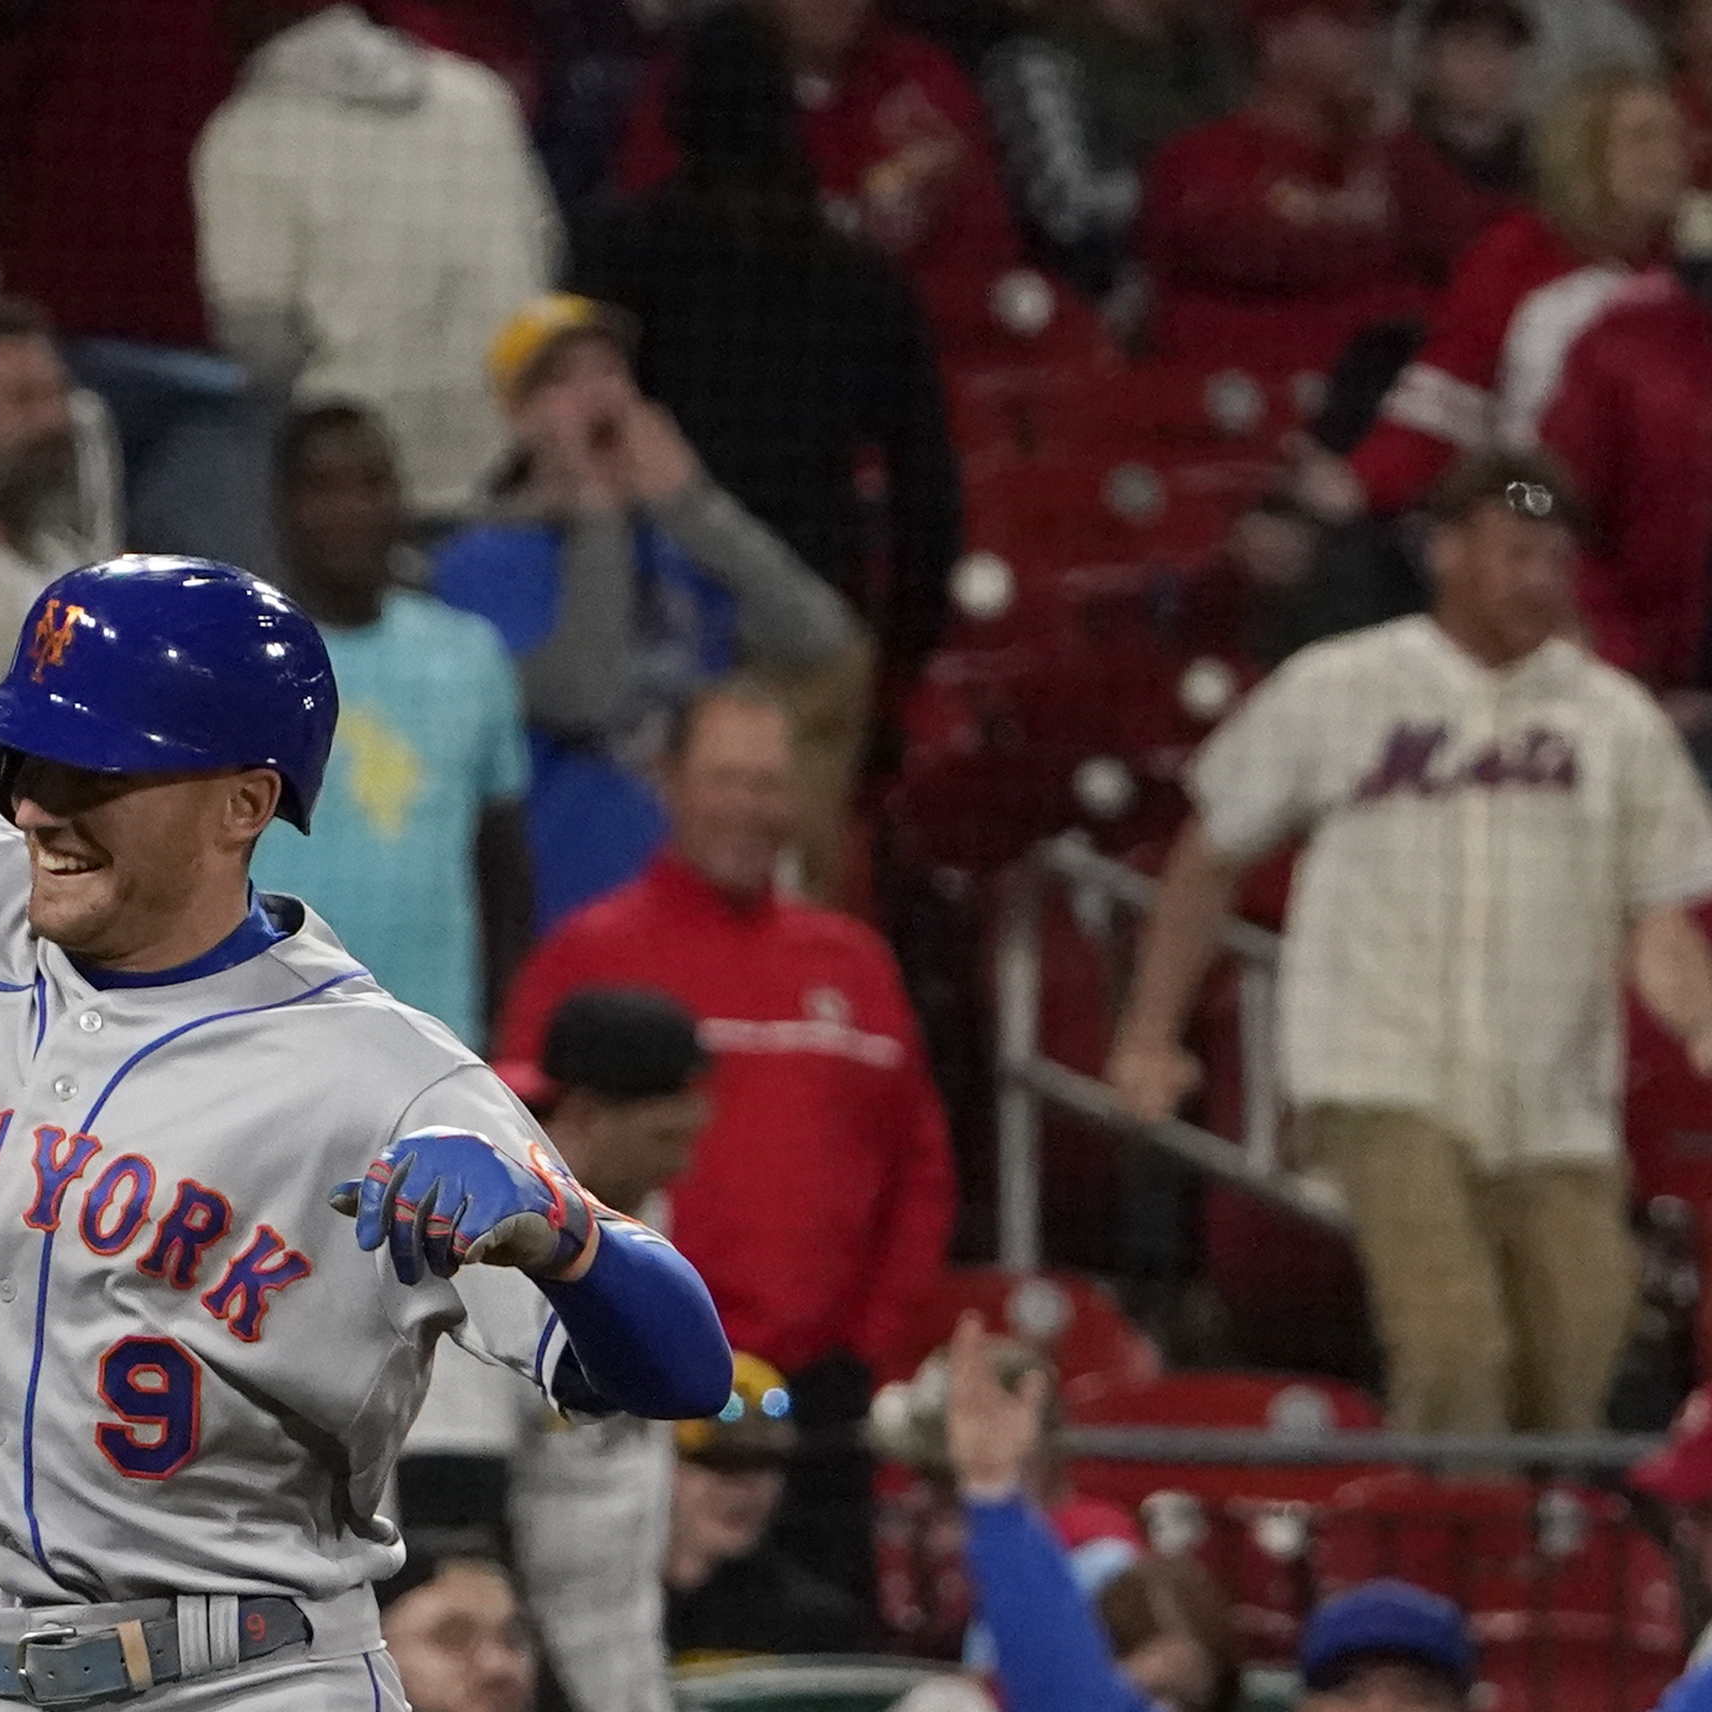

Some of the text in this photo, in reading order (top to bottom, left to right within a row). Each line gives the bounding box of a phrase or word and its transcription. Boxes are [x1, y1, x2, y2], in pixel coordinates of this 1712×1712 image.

[23, 1126, 311, 1342] YORK
[96, 1336, 201, 1480] 9
[246, 1613, 266, 1642] 9
